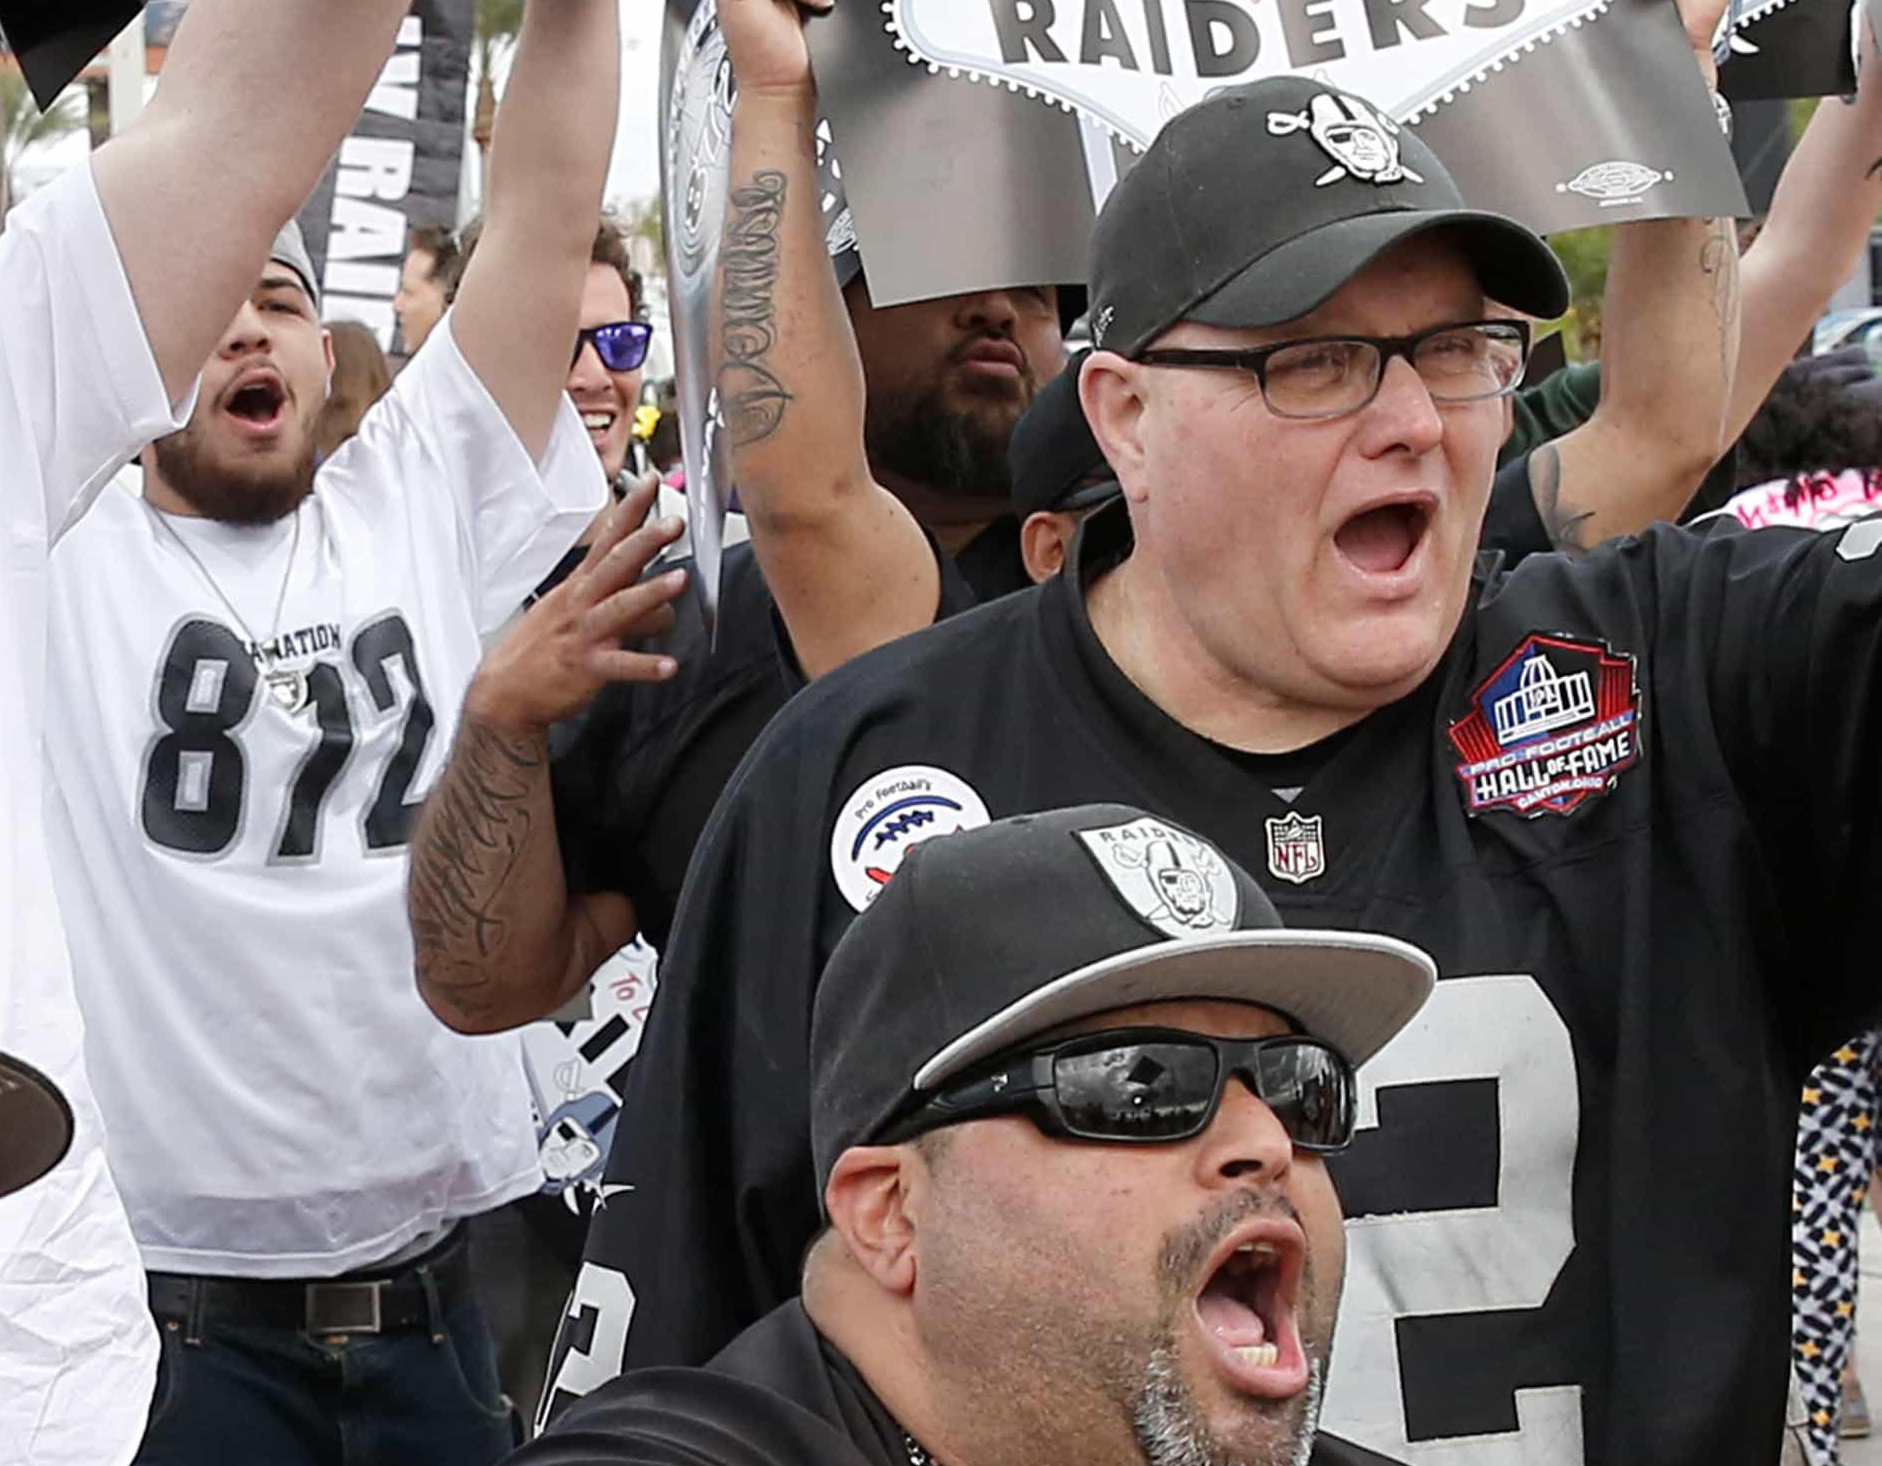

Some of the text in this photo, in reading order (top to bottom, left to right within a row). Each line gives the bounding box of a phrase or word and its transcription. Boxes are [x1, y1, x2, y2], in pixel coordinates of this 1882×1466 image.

[1476, 731, 1631, 801] HALL OF FAME
[855, 800, 875, 820] Pro
[1274, 841, 1318, 874] NFL
